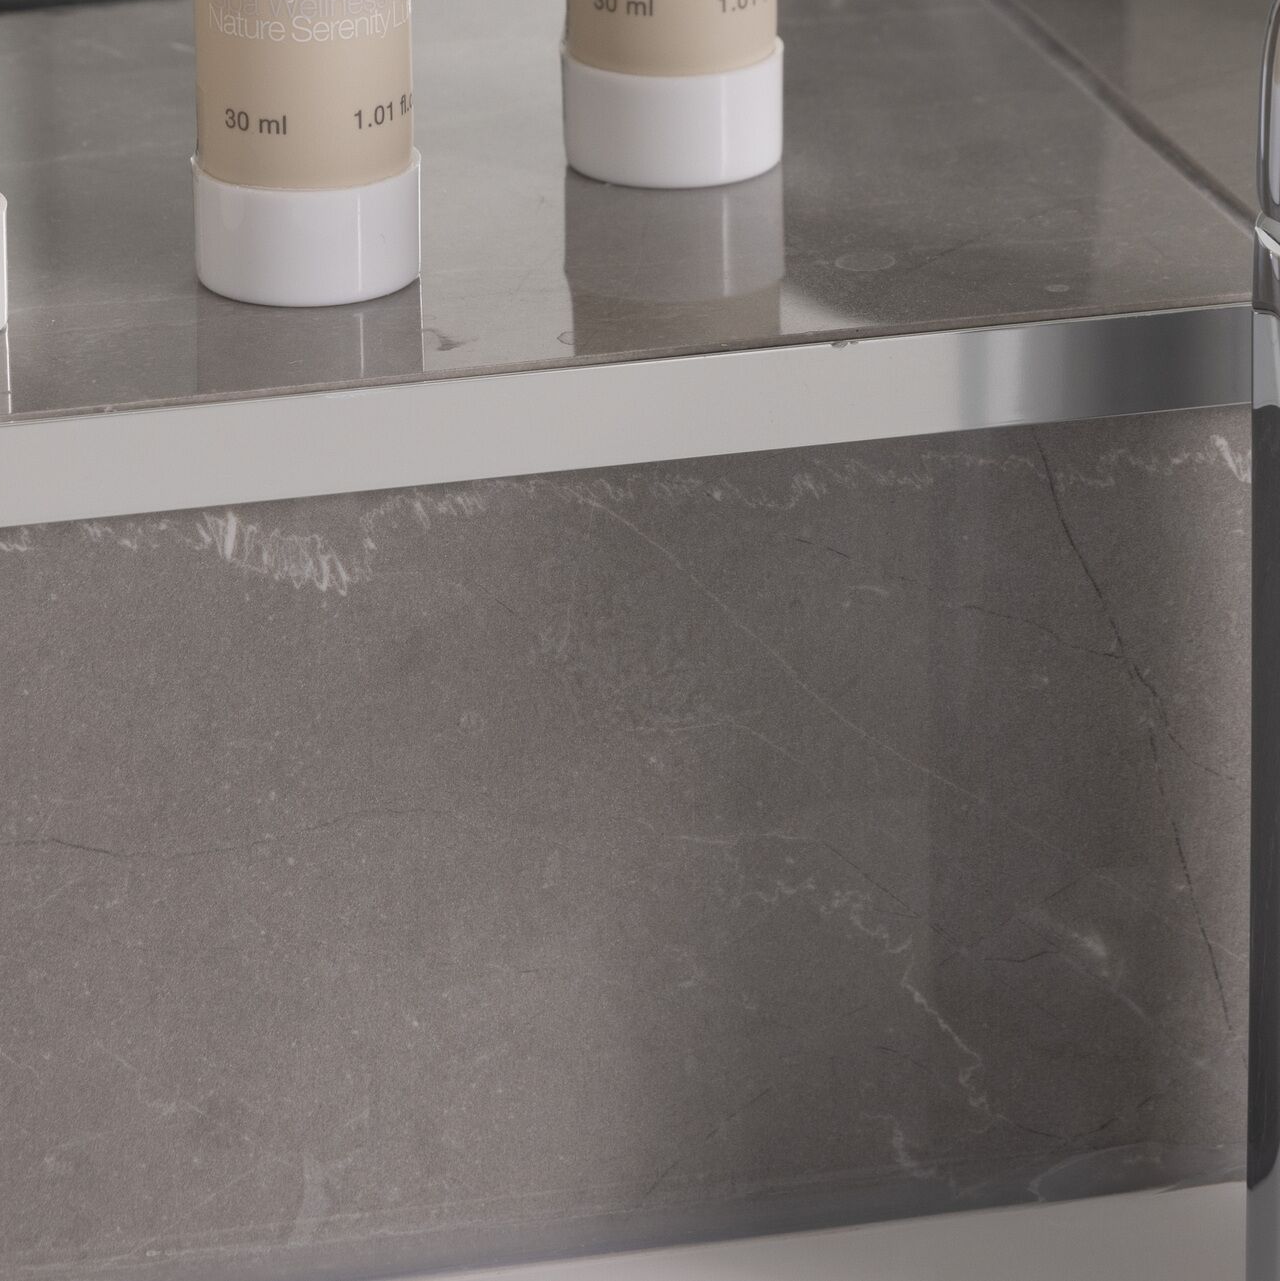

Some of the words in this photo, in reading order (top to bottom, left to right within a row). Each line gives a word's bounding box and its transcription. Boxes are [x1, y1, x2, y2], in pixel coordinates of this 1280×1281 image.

[208, 2, 286, 42] Nature
[291, 9, 391, 42] Serenity
[225, 108, 250, 132] 30
[259, 115, 287, 135] ml
[354, 102, 394, 130] 1.01
